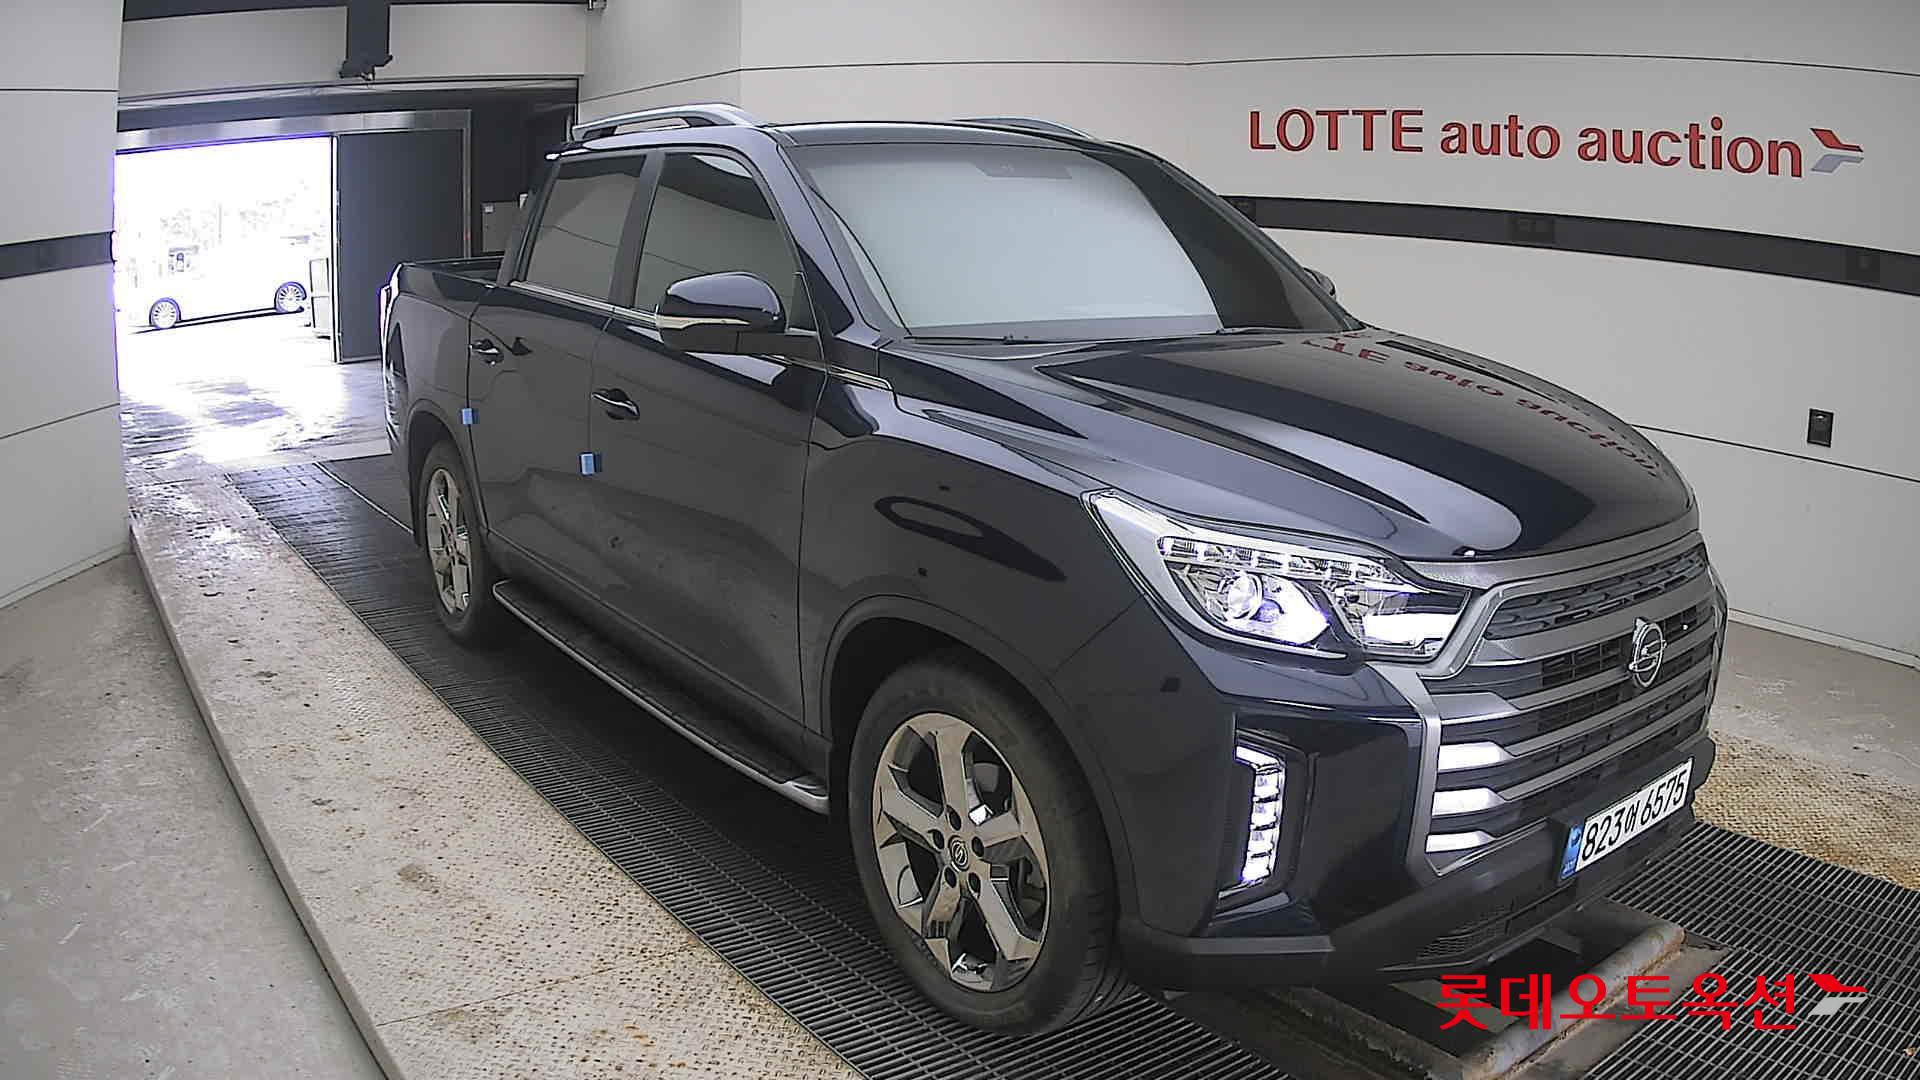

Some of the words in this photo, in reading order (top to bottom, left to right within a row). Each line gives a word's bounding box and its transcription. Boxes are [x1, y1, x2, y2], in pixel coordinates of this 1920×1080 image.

[1248, 108, 1425, 153] LOTTE
[1440, 115, 1562, 159] auto
[1577, 116, 1803, 178] auction
[1641, 769, 1687, 826] 6575
